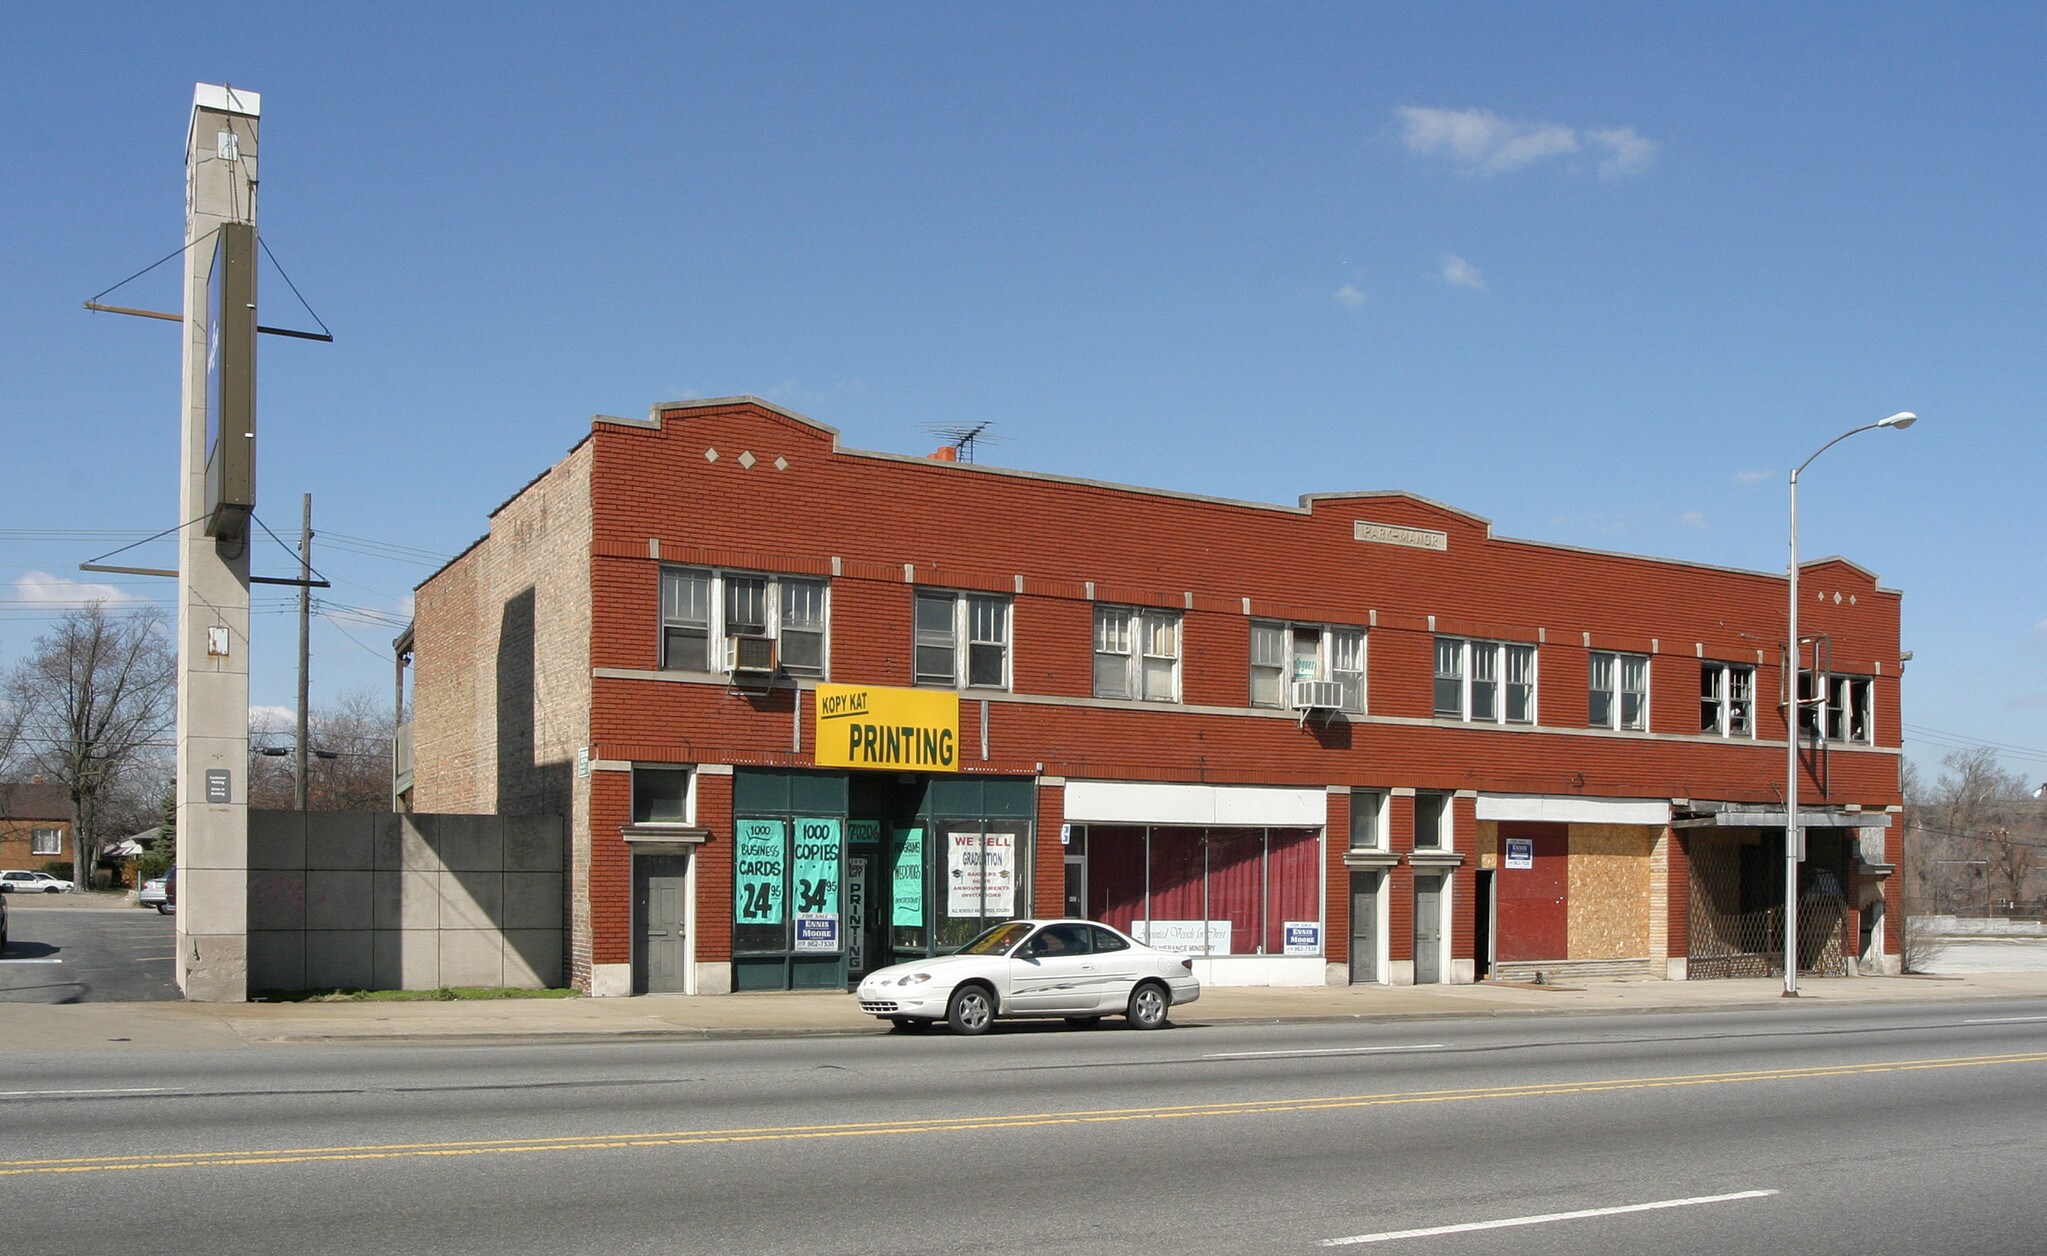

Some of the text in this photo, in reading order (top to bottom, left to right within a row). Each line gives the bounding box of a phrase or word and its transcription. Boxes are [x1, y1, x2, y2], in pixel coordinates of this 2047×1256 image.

[822, 692, 867, 714] KOPY KAT
[849, 723, 953, 766] PRINTING
[751, 825, 771, 836] 1000
[803, 824, 830, 840] 1000
[955, 836, 974, 846] WE
[741, 843, 780, 857] BUSINESS
[795, 844, 839, 861] COPIES
[962, 851, 1003, 866] GRADTION
[739, 860, 781, 876] CARDS
[743, 882, 781, 919] 24 95
[798, 879, 837, 913] 34 95
[805, 920, 829, 928] ENNIS
[849, 883, 862, 968] PRINTING
[802, 929, 832, 937] MOORE
[1188, 944, 1216, 952] MINISRY
